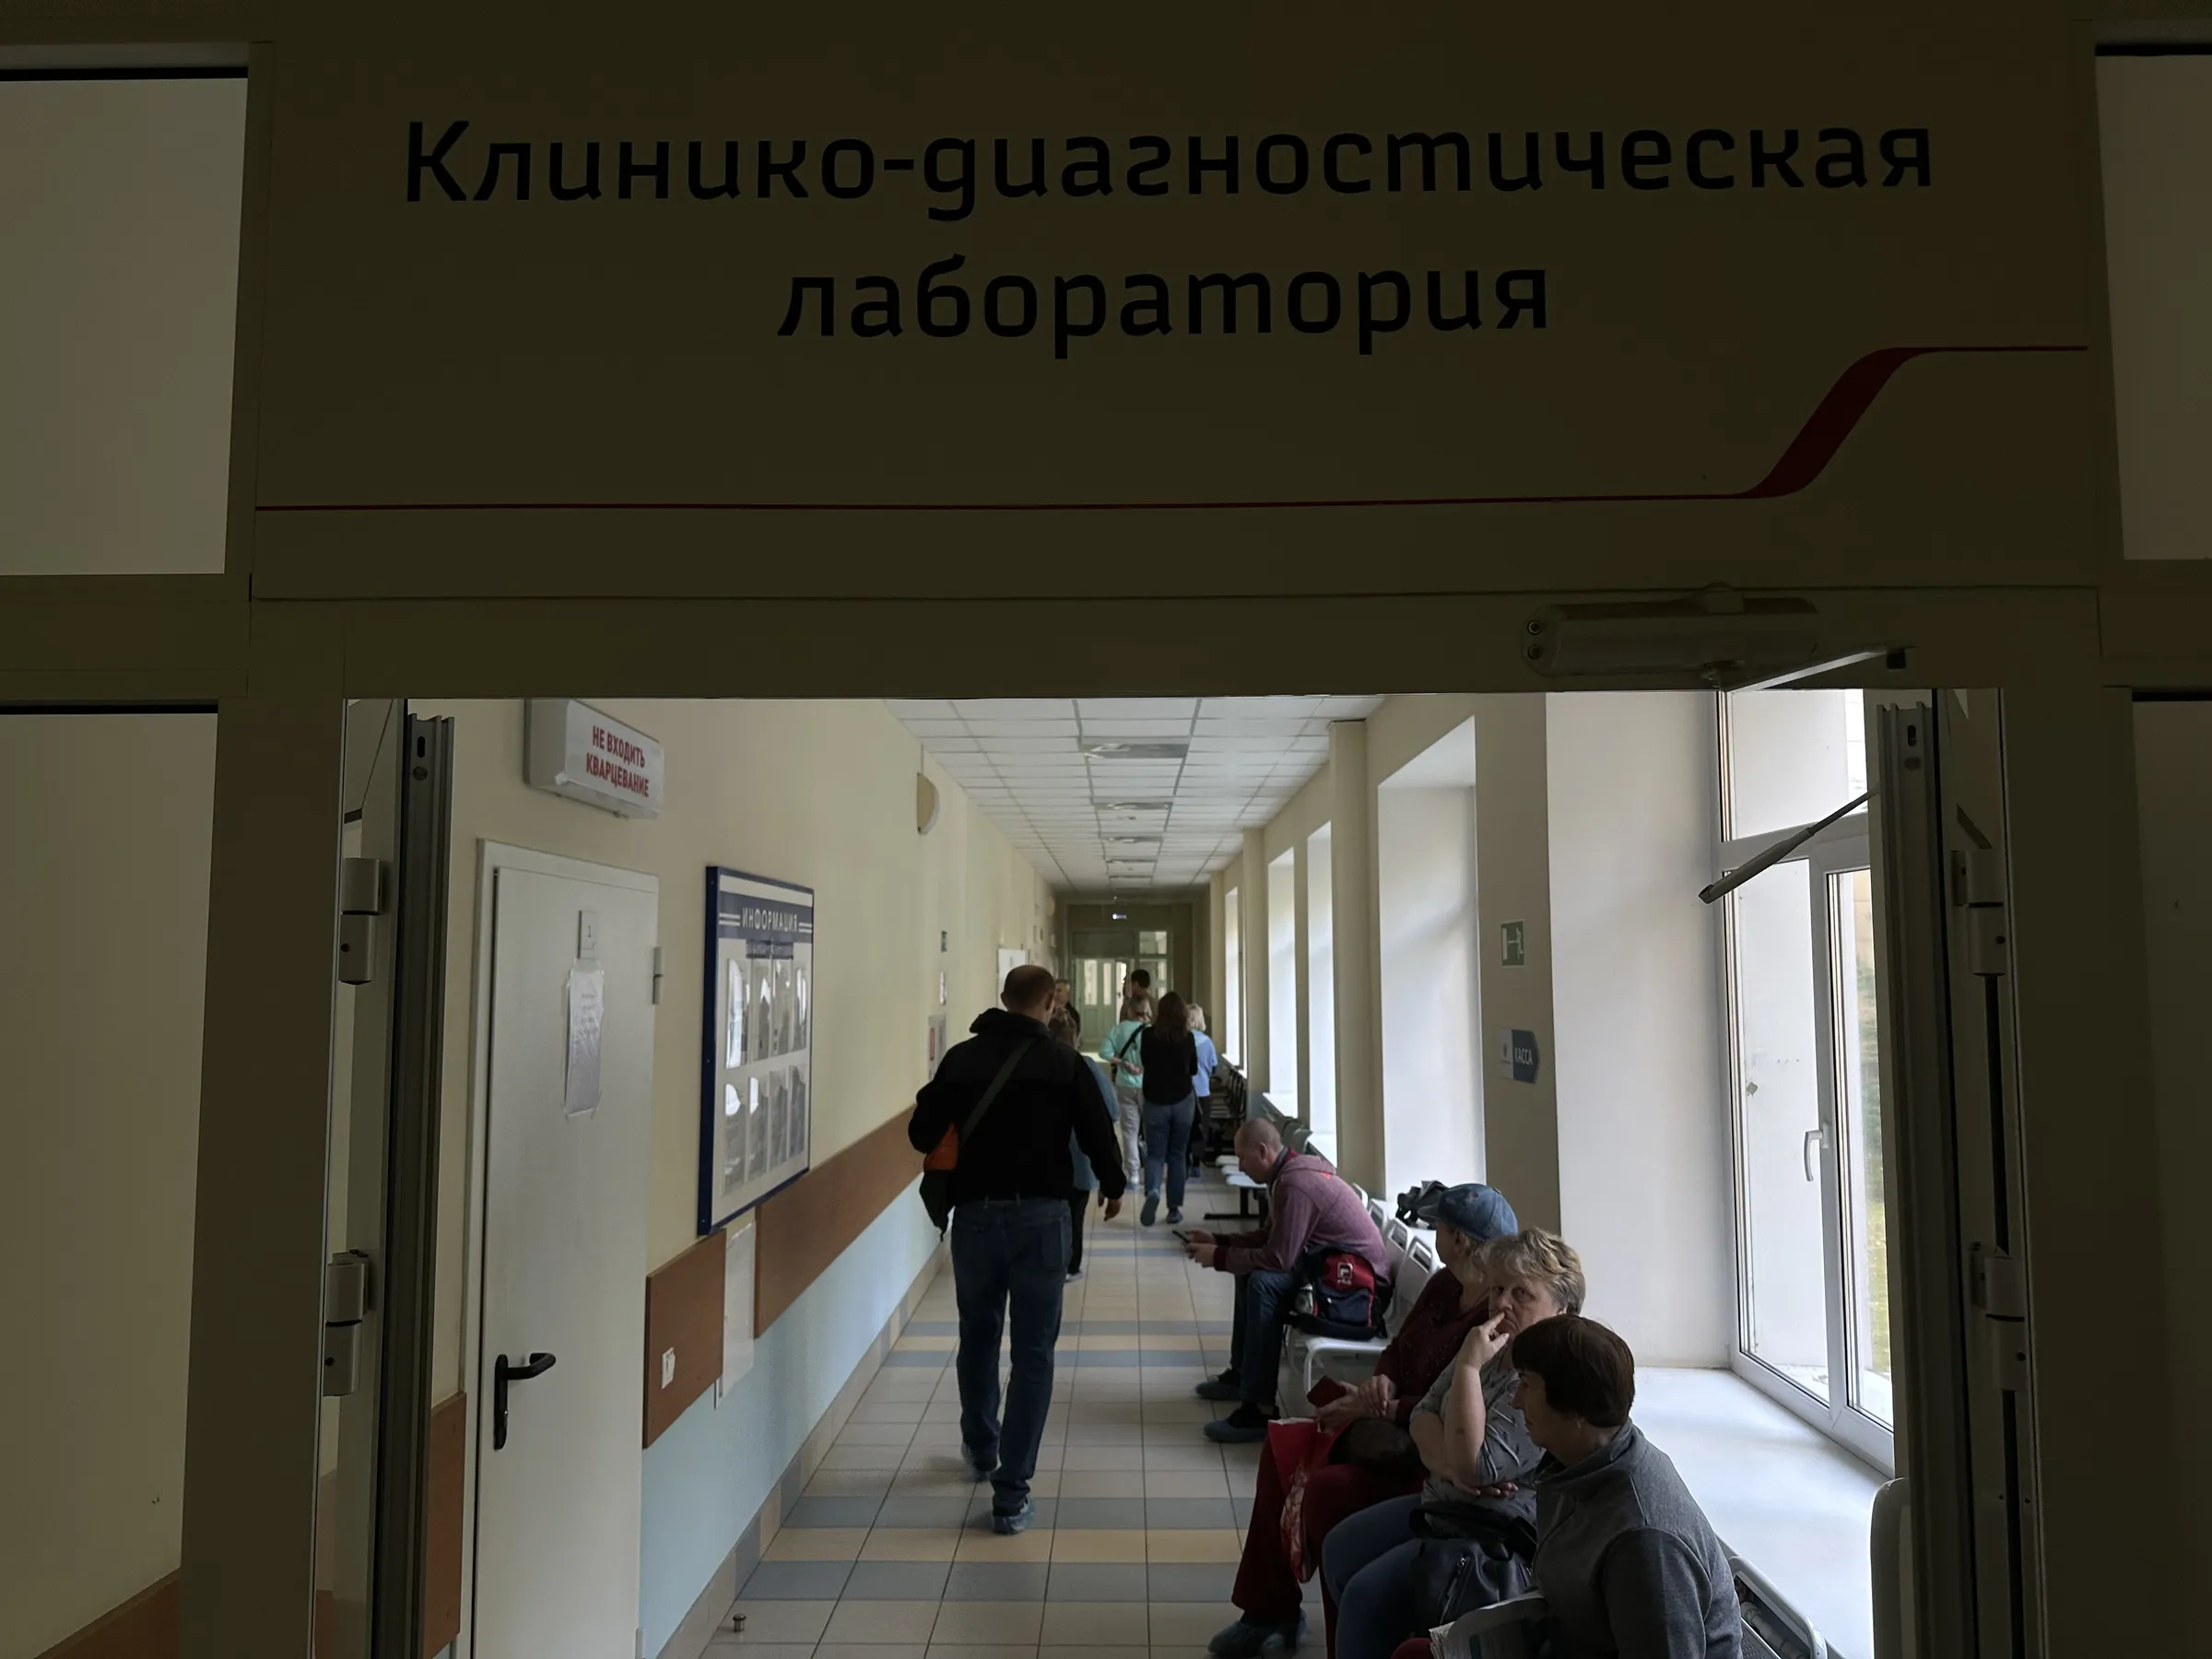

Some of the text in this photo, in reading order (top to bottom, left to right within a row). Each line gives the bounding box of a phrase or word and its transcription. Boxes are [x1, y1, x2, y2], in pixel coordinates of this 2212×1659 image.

[407, 121, 1931, 222] Клинико-диагностическая
[777, 253, 1547, 360] лаборатория
[593, 725, 646, 768] НЕ ВХОДИТЬ
[586, 753, 649, 798] КВАРЦЕВАНИЕ
[742, 907, 798, 933] ИНФОРМАЦИЯ
[1514, 1047, 1533, 1065] КАССА
